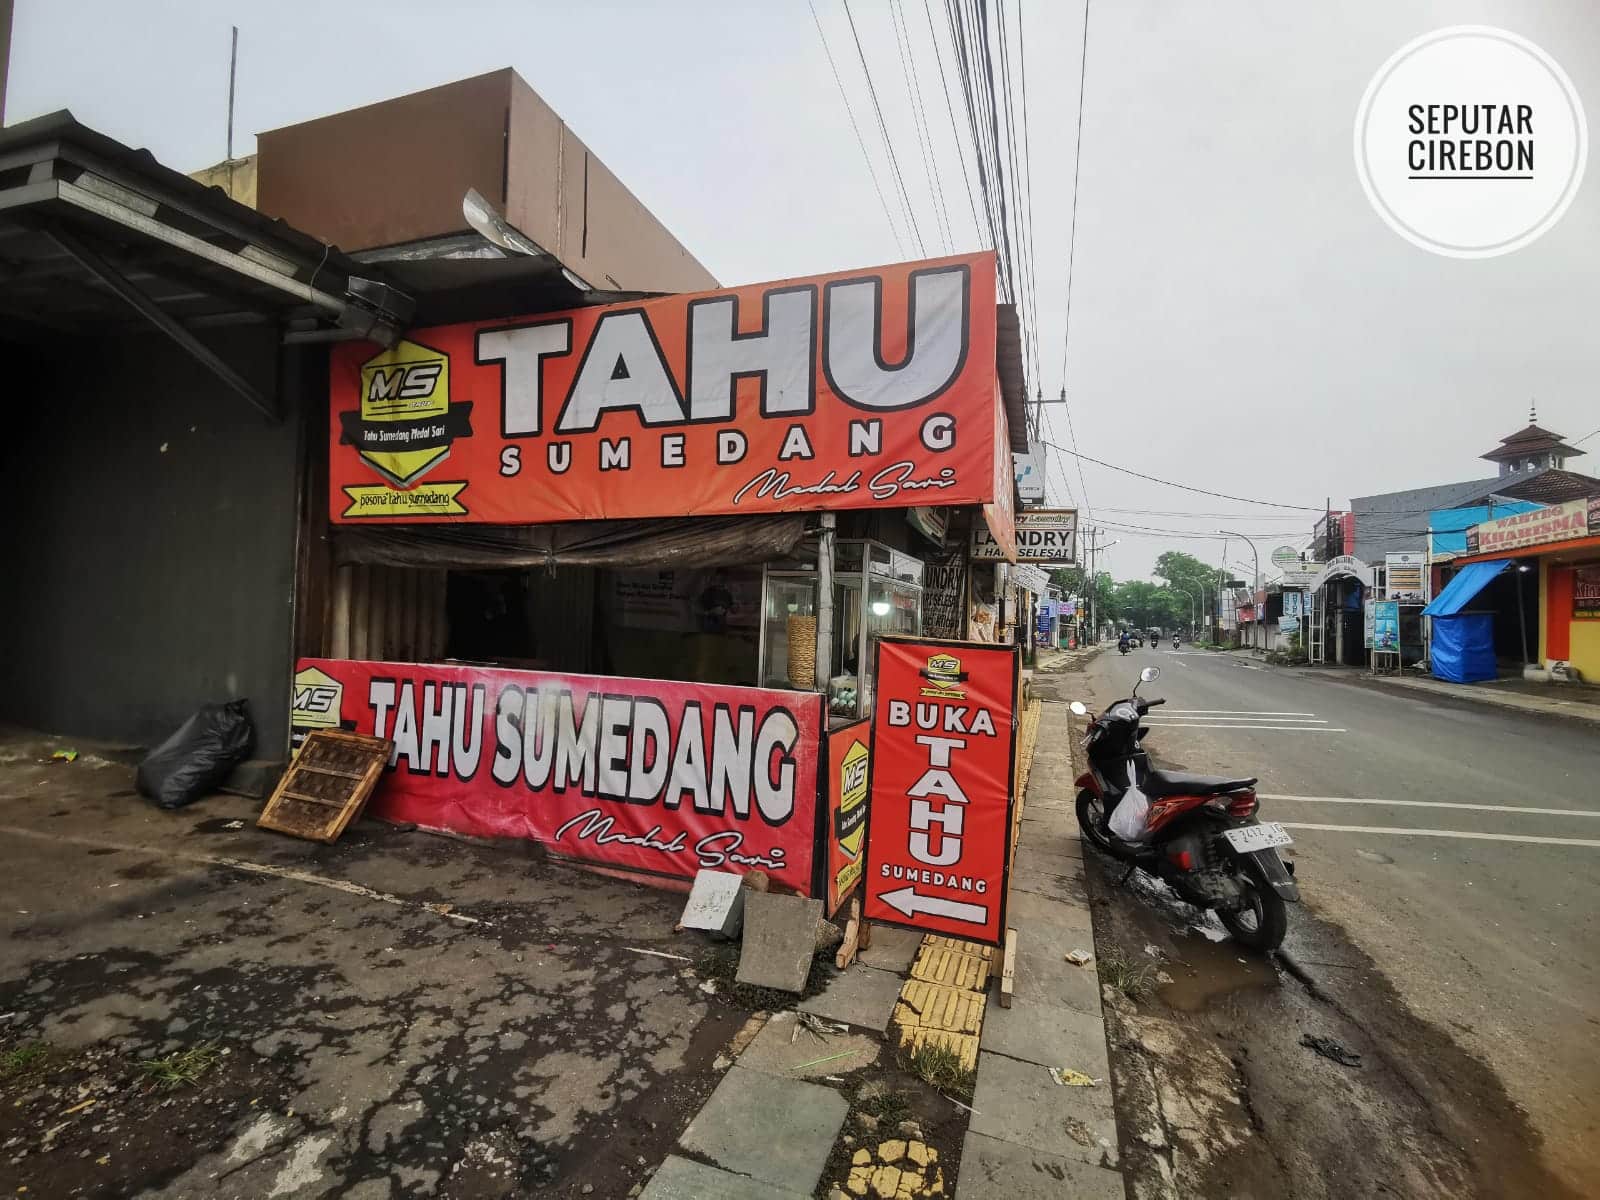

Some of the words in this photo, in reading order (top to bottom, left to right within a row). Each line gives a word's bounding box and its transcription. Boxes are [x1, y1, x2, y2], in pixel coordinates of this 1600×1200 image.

[475, 264, 970, 438] TAHU
[367, 364, 442, 402] MS
[379, 429, 409, 442] Sumedang
[432, 425, 445, 437] Sari
[500, 412, 957, 475] SUMEDANG
[734, 468, 858, 504] Medal
[869, 462, 956, 500] Sari
[974, 531, 1070, 546] LANDRY
[1018, 548, 1068, 558] SELESAI
[930, 660, 958, 669] MS
[292, 687, 337, 712] MS
[887, 699, 997, 737] BUKA
[368, 677, 486, 783] TAHU
[491, 683, 799, 827] SUMEDANG
[843, 757, 867, 795] MS
[906, 735, 970, 866] TAHU
[555, 808, 688, 852] Medal
[696, 830, 786, 869] Sari
[880, 863, 987, 894] SUMEDANG
